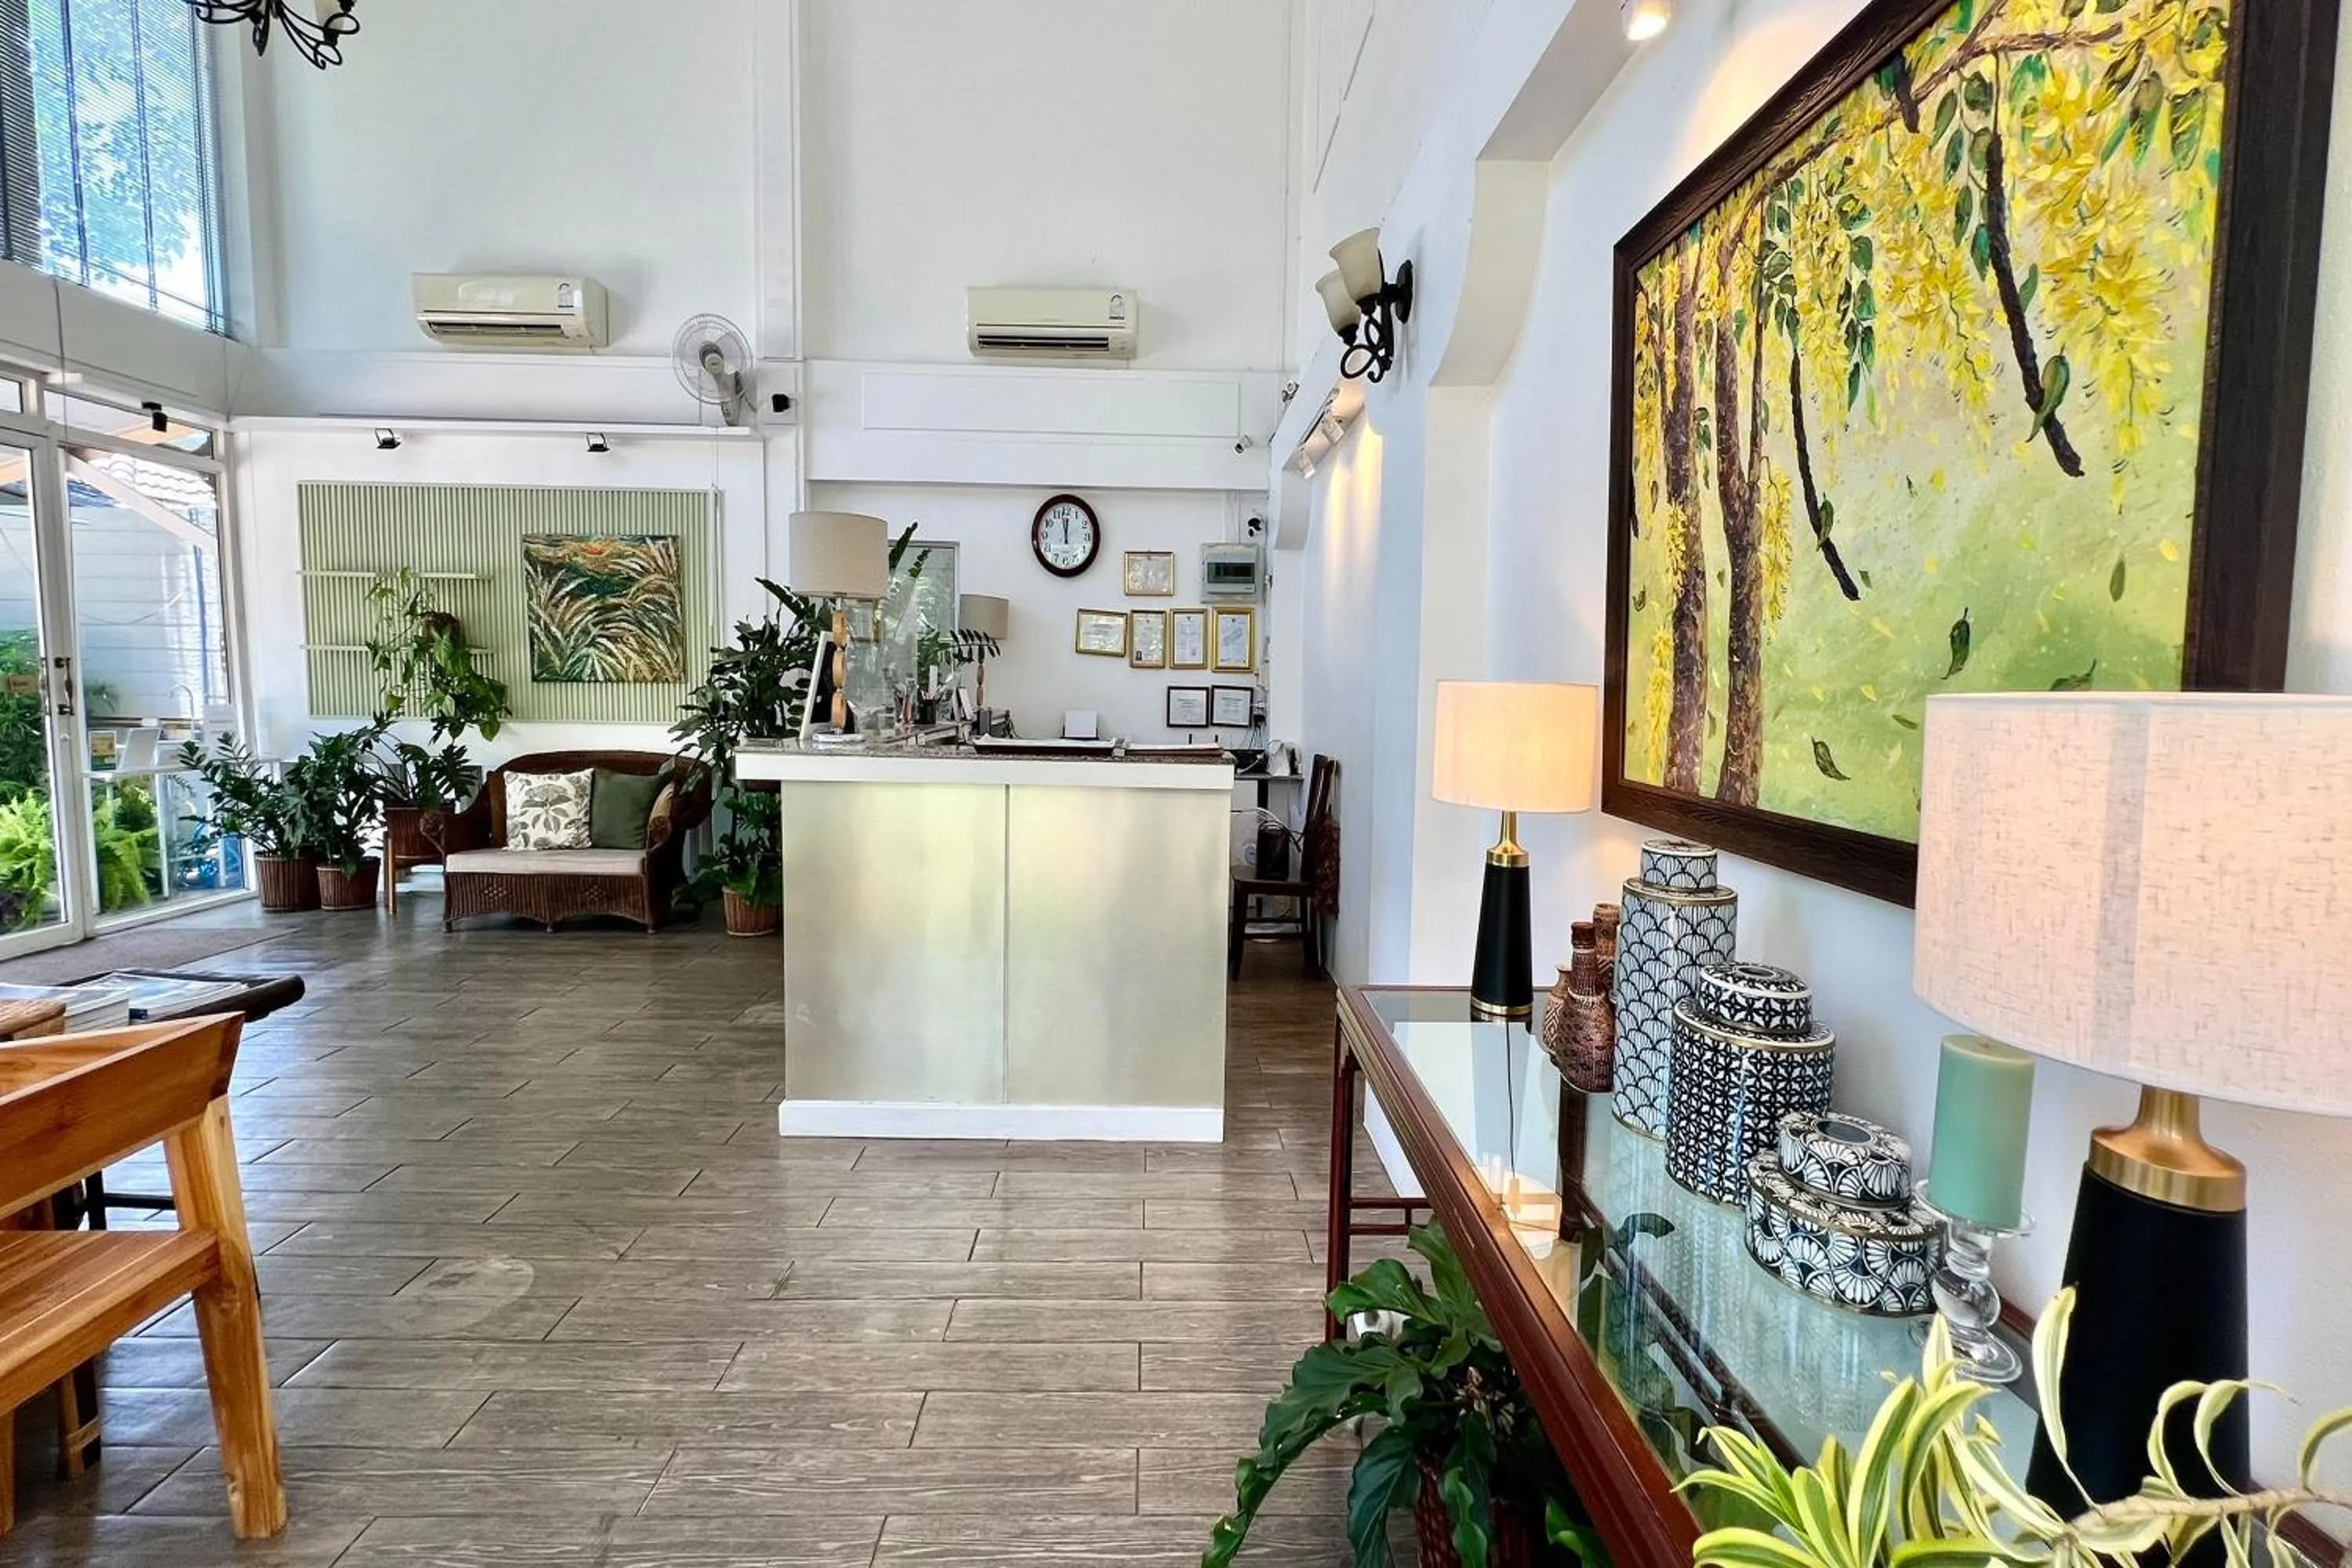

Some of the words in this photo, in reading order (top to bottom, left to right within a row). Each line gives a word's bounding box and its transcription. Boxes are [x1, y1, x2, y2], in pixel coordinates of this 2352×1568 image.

[1053, 510, 1061, 519] 11
[1074, 510, 1079, 519] 1
[1081, 520, 1088, 529] 2
